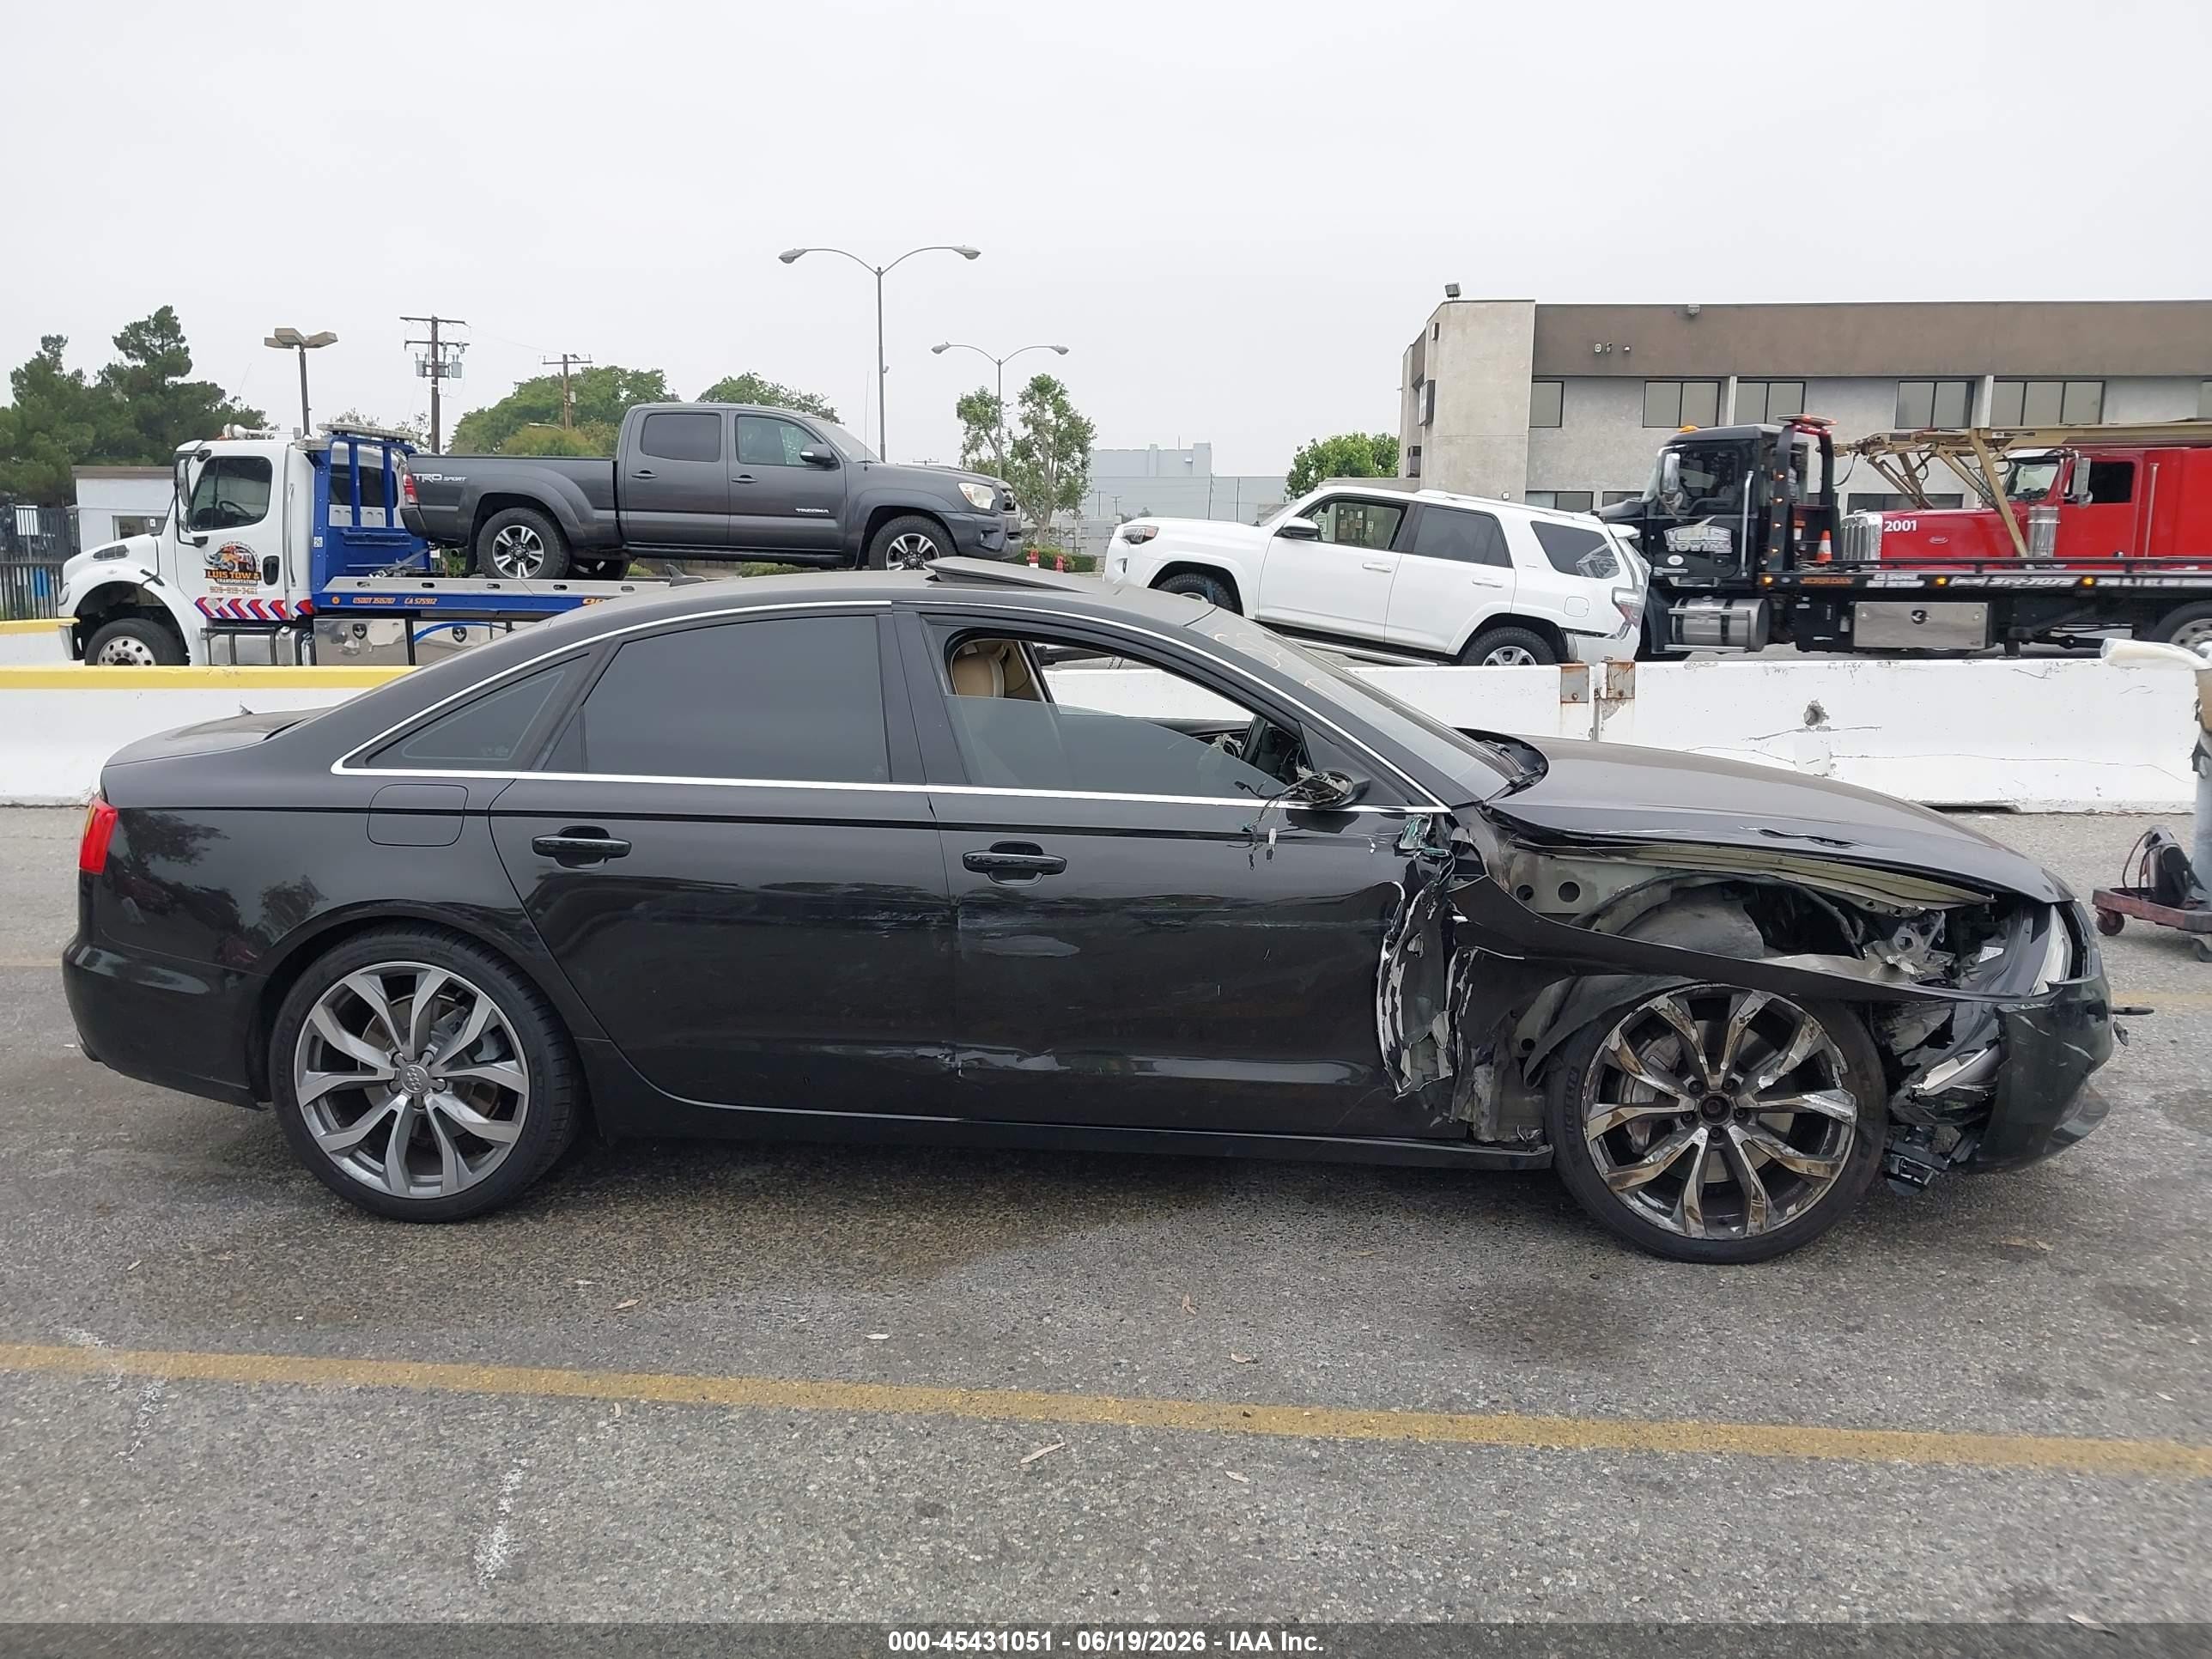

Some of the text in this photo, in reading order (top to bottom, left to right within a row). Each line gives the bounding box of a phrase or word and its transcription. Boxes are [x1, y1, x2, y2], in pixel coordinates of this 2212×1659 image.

[412, 473, 442, 483] TRD
[1883, 520, 1917, 532] 2001
[229, 571, 252, 580] TOW
